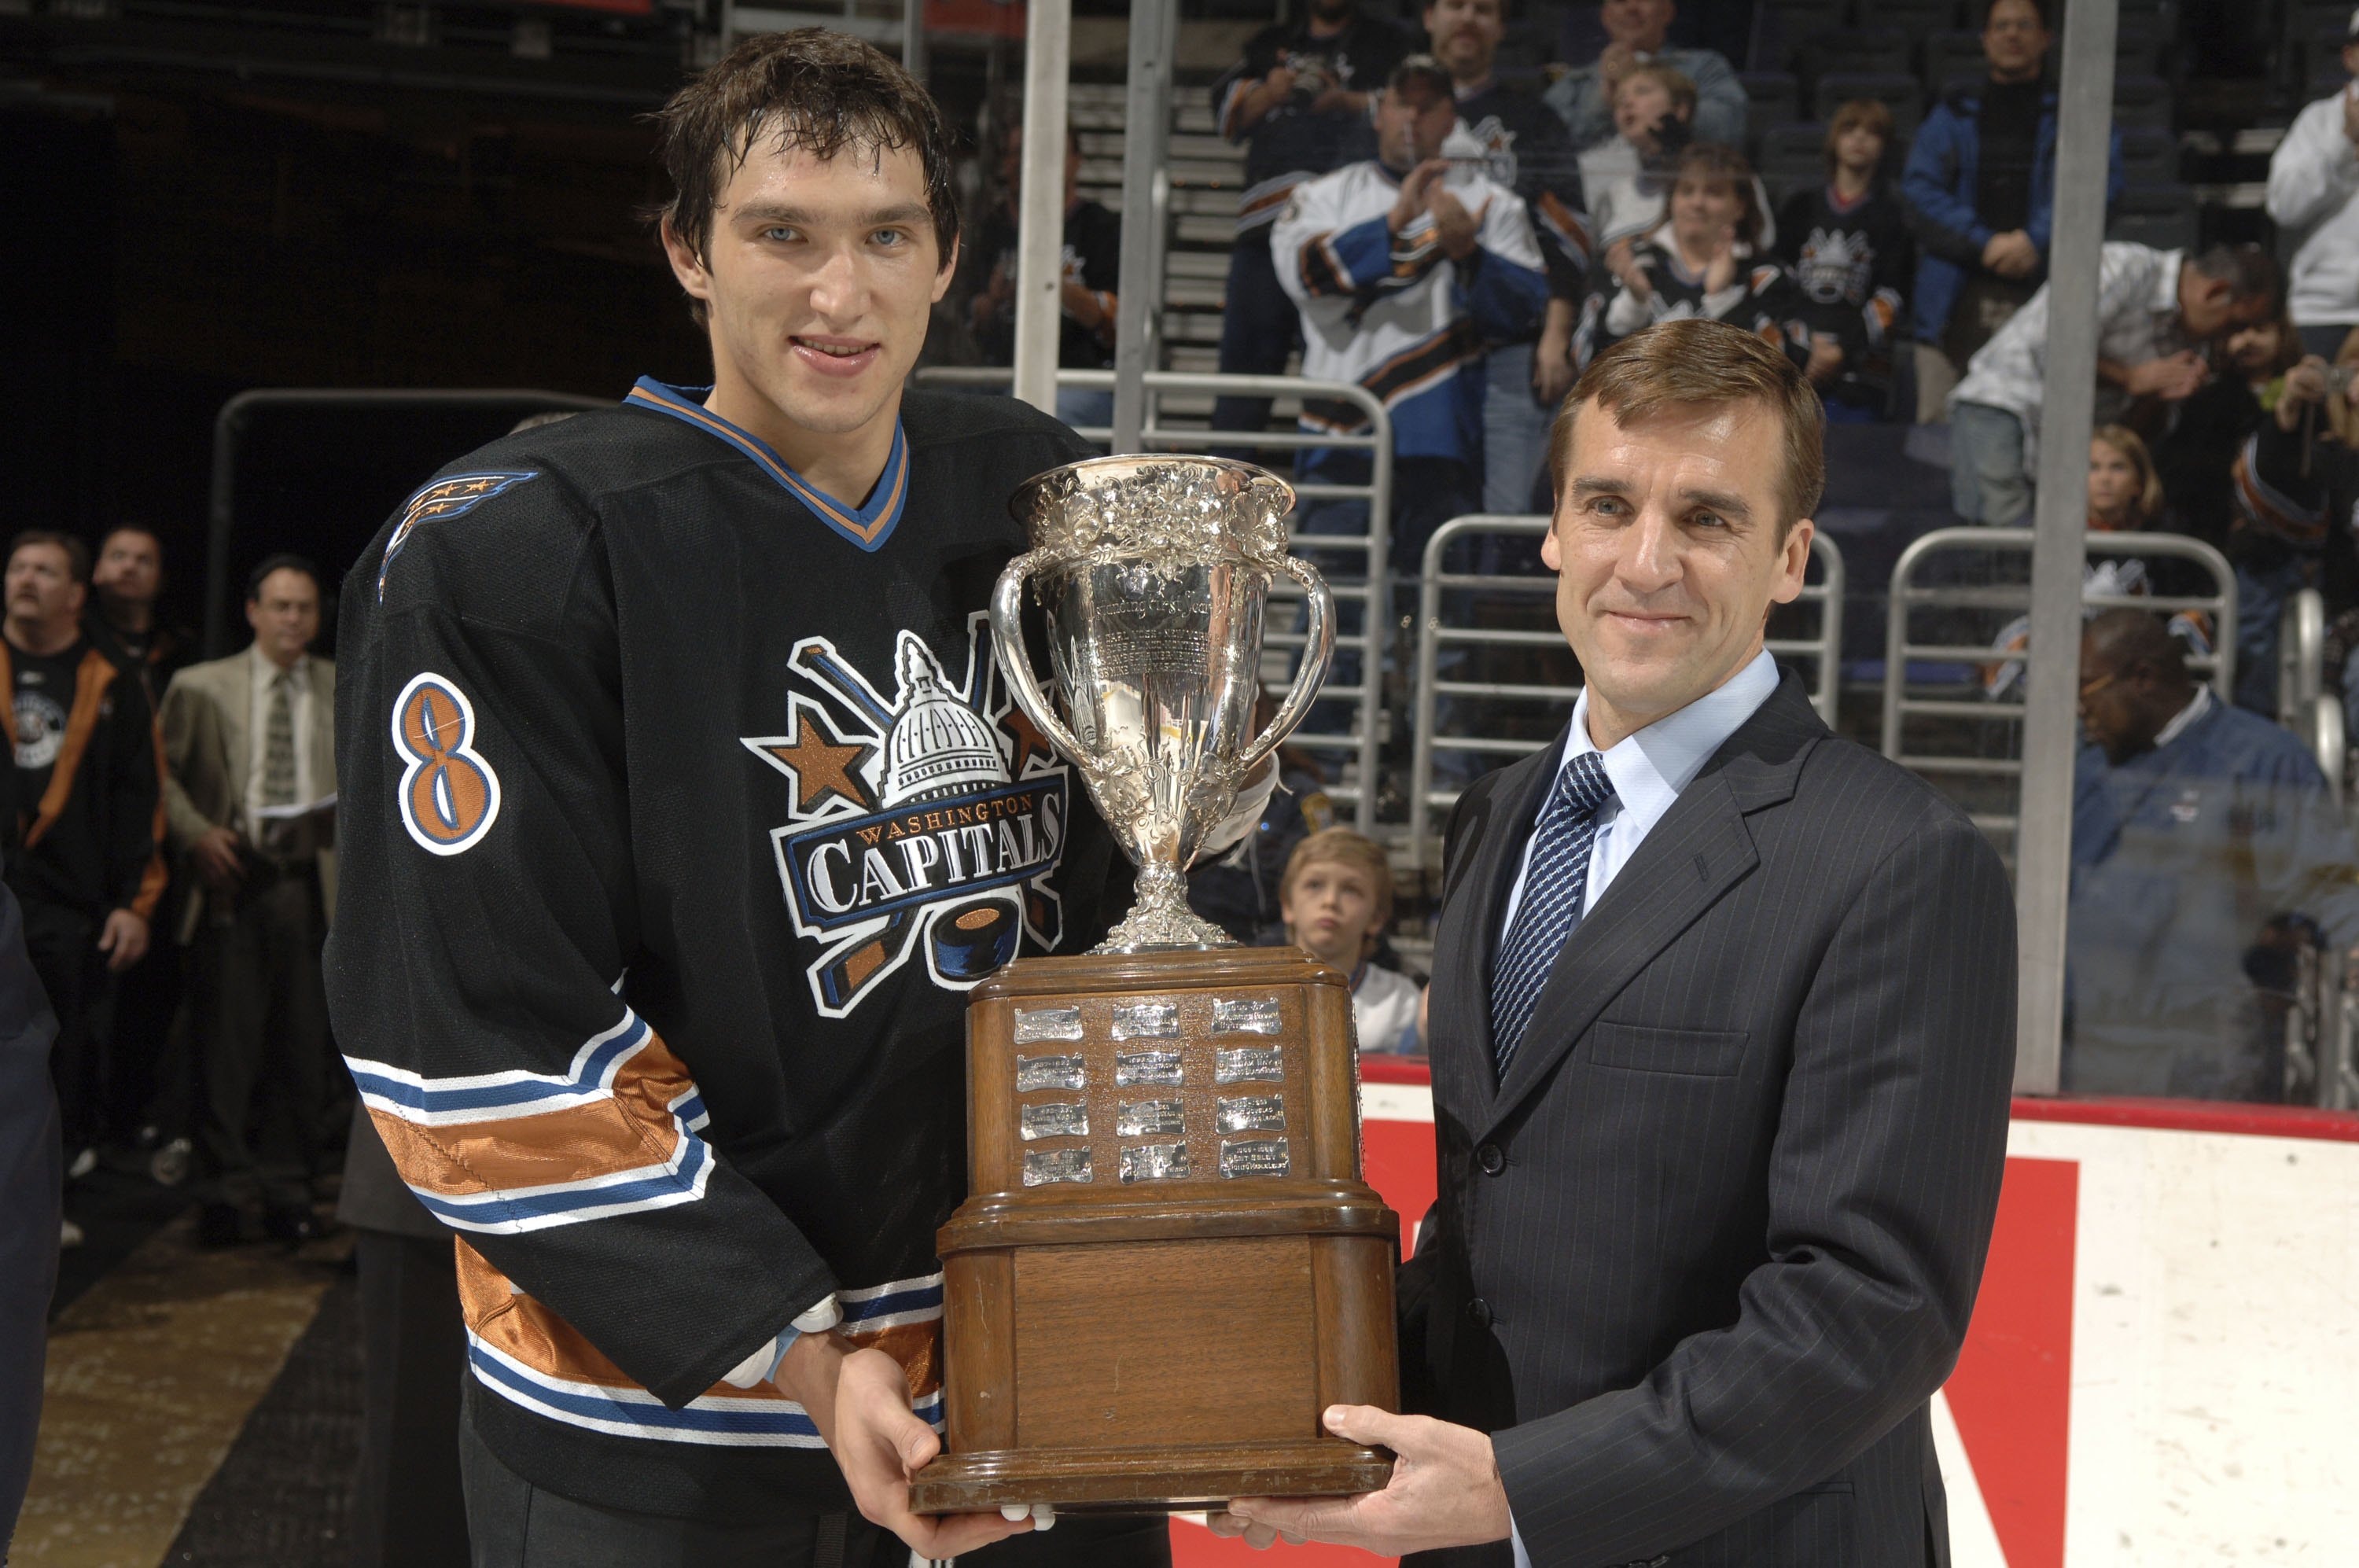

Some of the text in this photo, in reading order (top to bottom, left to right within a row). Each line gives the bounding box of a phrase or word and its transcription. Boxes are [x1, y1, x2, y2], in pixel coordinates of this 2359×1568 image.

[392, 671, 501, 856] 8
[856, 793, 1033, 845] WASHINGTON
[806, 792, 1062, 913] CAPITALS
